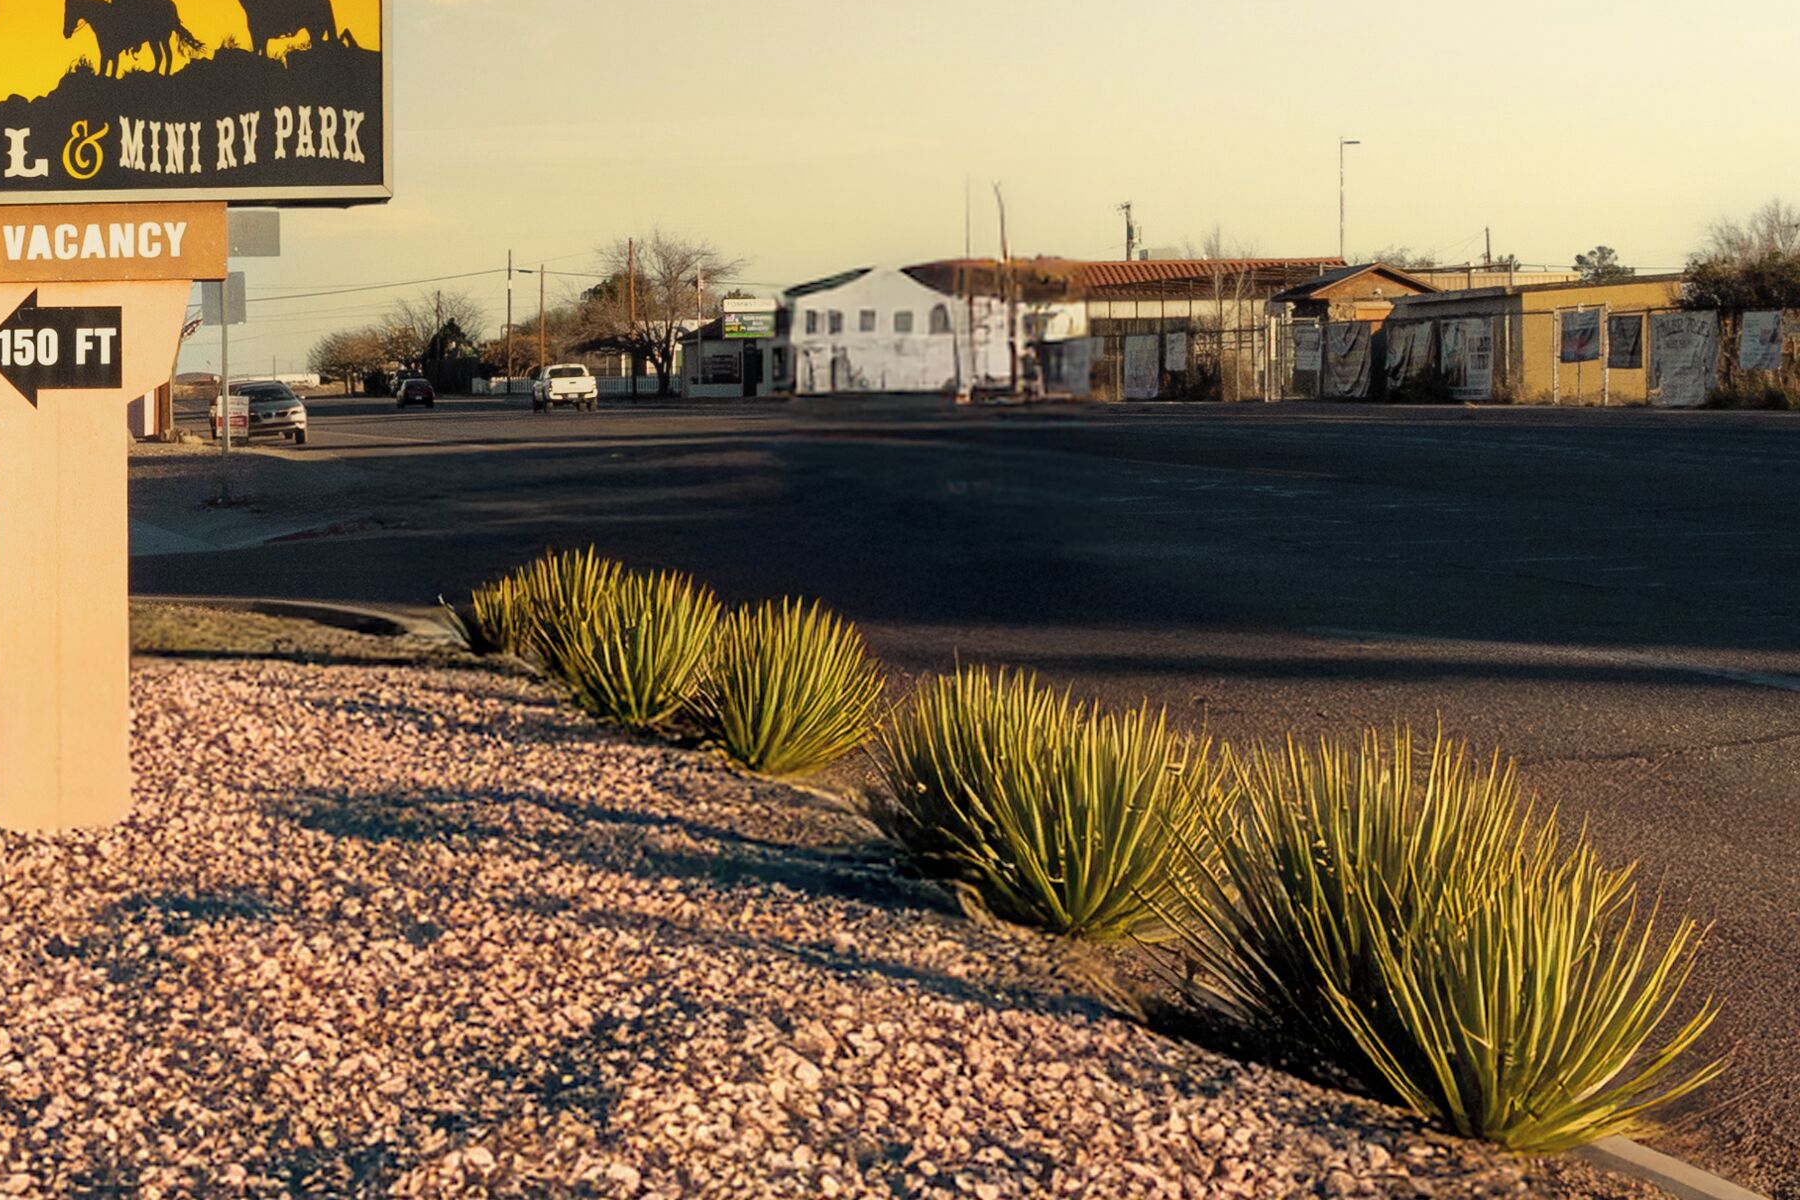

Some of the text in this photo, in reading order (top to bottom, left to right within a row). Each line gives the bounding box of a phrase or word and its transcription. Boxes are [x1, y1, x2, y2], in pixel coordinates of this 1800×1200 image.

[62, 119, 109, 180] &
[119, 115, 202, 174] MINI
[216, 112, 260, 170] RV
[274, 105, 366, 164] PARK
[3, 221, 187, 261] VACANCY
[75, 327, 117, 366] FT
